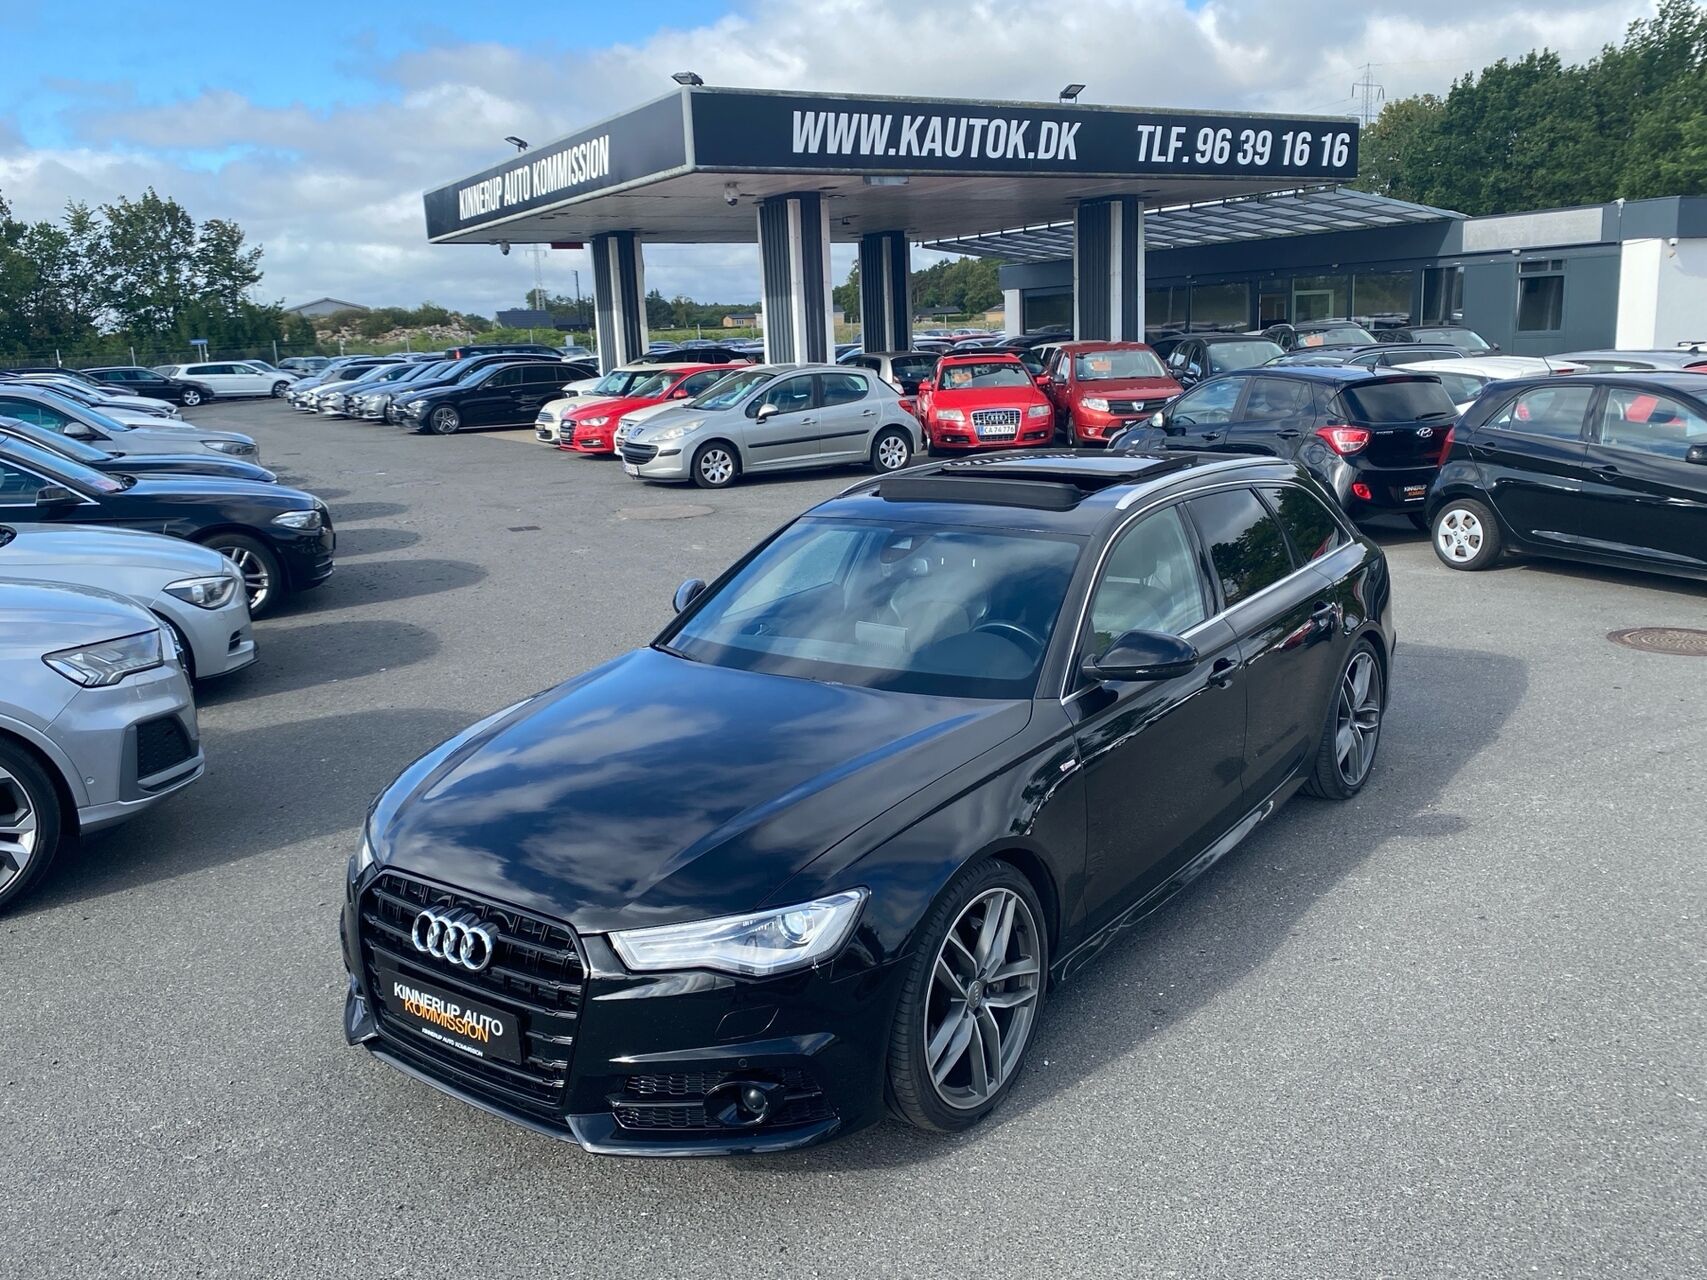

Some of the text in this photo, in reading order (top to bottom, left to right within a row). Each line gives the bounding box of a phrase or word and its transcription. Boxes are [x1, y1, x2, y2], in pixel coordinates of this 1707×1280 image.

[792, 110, 1082, 160] WWW.KAUTOK.DK
[1137, 125, 1350, 167] TLF. 96 39 16 16
[458, 134, 610, 221] KINNERUP AUTO KOMMISSION
[394, 982, 504, 1037] KINNERUP AUTO
[404, 997, 489, 1043] KOMMISSION
